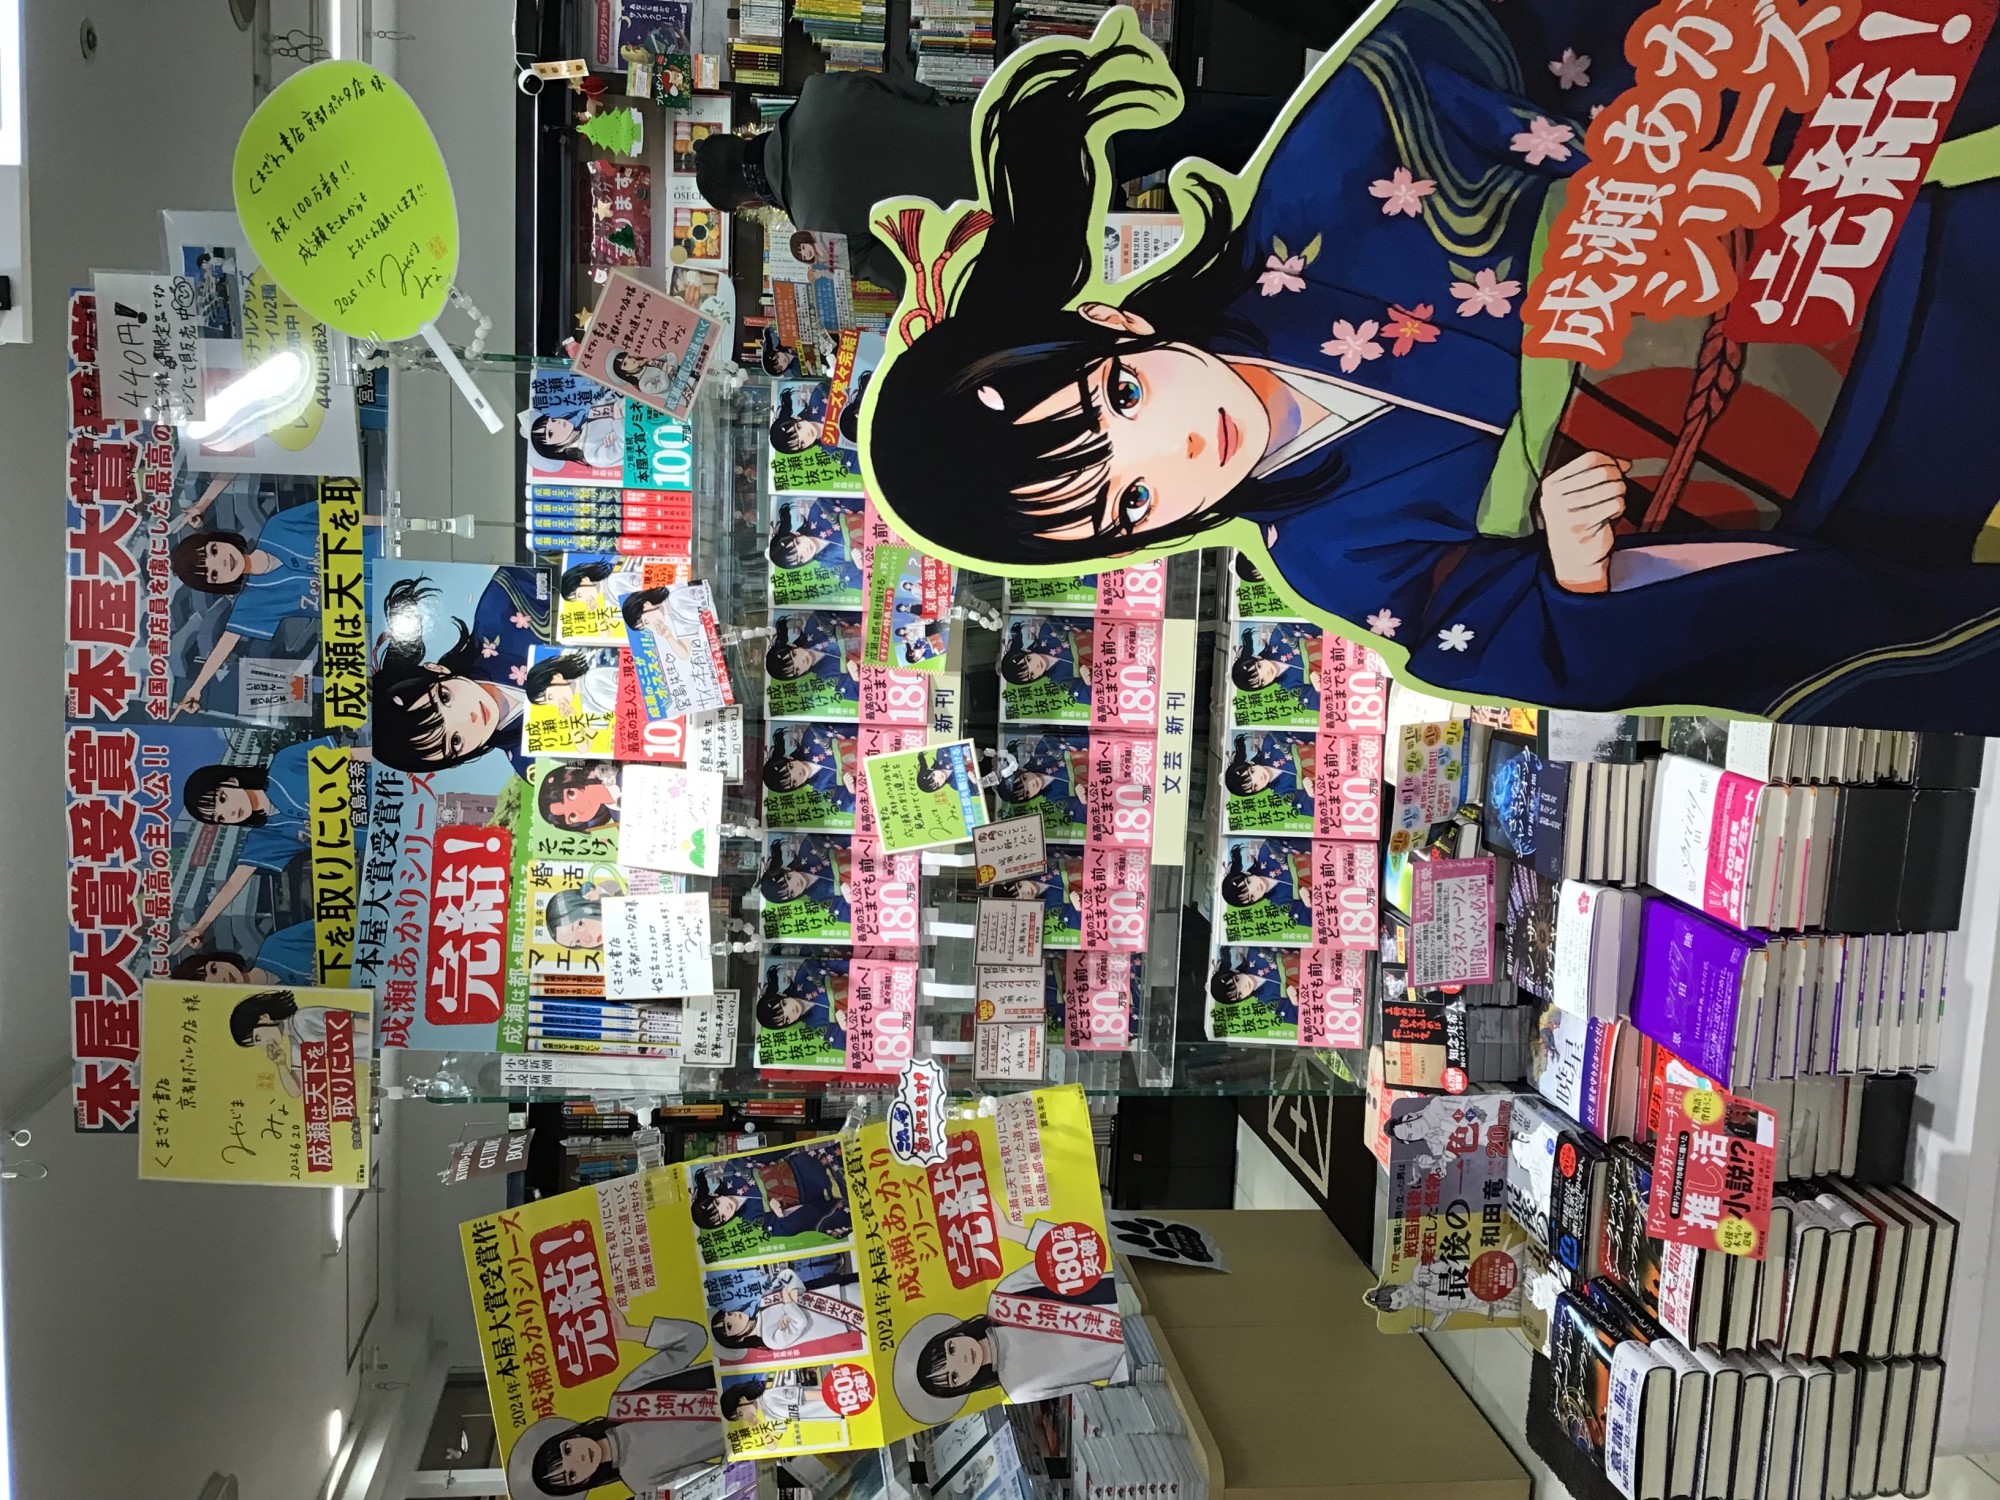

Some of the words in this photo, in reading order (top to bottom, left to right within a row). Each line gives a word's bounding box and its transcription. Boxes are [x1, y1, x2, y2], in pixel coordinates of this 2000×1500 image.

[629, 11, 675, 23] サンタクロース
[1641, 0, 1843, 309] シリーズ
[1747, 9, 1973, 327] 完結!
[114, 302, 149, 407] 440円!
[665, 319, 710, 411] 成瀬は信じた道をいく
[820, 329, 859, 445] シリーズ堂々完結!
[652, 424, 692, 487] 100
[146, 424, 171, 719] 全国の書店員を虜にした最高の
[561, 620, 621, 638] 取りにいく
[869, 577, 886, 661] 成瀬は都を駆け抜ける
[879, 587, 896, 662] オリジナル特典しおり
[701, 609, 734, 701] 成瀬は天下を取りにいく
[525, 711, 614, 737] 成瀬は天下を
[623, 650, 640, 753] 最高の主人公、現る!
[933, 688, 955, 733] 新刊
[1164, 691, 1186, 735] 新刊
[527, 730, 599, 752] 取りにいく
[1161, 750, 1183, 794] 文芸
[858, 769, 872, 833] 最高の主人公と
[1098, 740, 1115, 836] どこまでも前へ!
[1316, 774, 1330, 835] 最高の主人公と
[1323, 734, 1342, 829] どこまでも前へ!
[1401, 776, 1415, 805] 第1位
[311, 754, 357, 981] 下を取りにいく
[530, 862, 586, 889] 婚活
[537, 836, 619, 856] それいけ!
[1724, 820, 1740, 880] 2025年
[1729, 788, 1755, 922] 本屋大賞ノミネート
[379, 771, 436, 1049] 成瀬あかりシリーズ
[761, 900, 831, 922] 成瀬は都を
[852, 880, 867, 943] 最高の主人公と
[859, 839, 879, 936] どこまでも前へ!
[1083, 888, 1096, 948] 最高の主人公と
[1091, 847, 1108, 941] どこまでも前へ!
[1315, 884, 1328, 945] 最高の主人公と
[1320, 844, 1340, 939] どこまでも前へ!
[1421, 867, 1433, 916] 入山章栄
[67, 730, 140, 1127] 本屋大賞受賞
[430, 835, 506, 1014] 完結!
[764, 913, 837, 939] 駆け抜ける
[1469, 876, 1488, 978] 間違いなく必読!
[856, 966, 874, 1064] どこまでも前へ!
[1067, 989, 1080, 1047] 最高の主人公と
[1074, 950, 1092, 1041] どこまでも前へ!
[1678, 981, 1688, 997] 田
[505, 1057, 553, 1069] 小説新潮
[757, 1026, 826, 1048] 成瀬は都を
[758, 1041, 832, 1065] 駆け抜ける
[849, 1007, 862, 1070] 最高の主人公と
[875, 1011, 912, 1071] 180
[1446, 1001, 1461, 1061] 知念実希人
[327, 1017, 355, 1118] 取りにいく
[505, 1074, 553, 1085] 小説新潮
[1554, 1037, 1584, 1106] 暁星
[152, 1077, 173, 1169] くまざわ書店
[221, 1099, 257, 1165] みやじま
[260, 1098, 289, 1140] みな
[303, 1044, 332, 1167] 成瀬は天下を
[478, 1136, 503, 1169] GUIDE
[505, 1133, 528, 1162] BOOK
[1009, 1100, 1036, 1208] 成瀬は信じた道をいく
[1022, 1096, 1050, 1207] 成瀬は都を駆け抜ける
[1671, 1134, 1689, 1215] 朝井リョウが10年前に描いた
[1722, 1140, 1755, 1220] 小説!?
[612, 1184, 641, 1291] 成瀬は信じた道をいく
[628, 1179, 656, 1288] 成瀬は都を駆け抜ける
[869, 1147, 926, 1302] 成瀬あかり
[903, 1175, 939, 1262] シリーズ
[933, 1138, 1000, 1277] 完結!
[1403, 1176, 1423, 1259] 戦国最後に
[1420, 1167, 1441, 1266] 実在した怪物。
[1480, 1178, 1504, 1247] 和田竜
[1723, 1219, 1735, 1248] 応援する
[1734, 1224, 1743, 1248] 本当の
[1742, 1230, 1753, 1247] 意味
[1053, 1240, 1085, 1294] 180
[1077, 1229, 1102, 1277] 突破!
[471, 1219, 527, 1428] 2024年本屋大賞受賞作
[497, 1210, 557, 1419] 成瀬あかりシリーズ
[539, 1229, 617, 1376] 完結!
[614, 1393, 717, 1419] びわ湖大津
[832, 1377, 860, 1416] 180
[853, 1369, 873, 1403] 突破!
[1609, 1368, 1630, 1478] 意識と脳の
